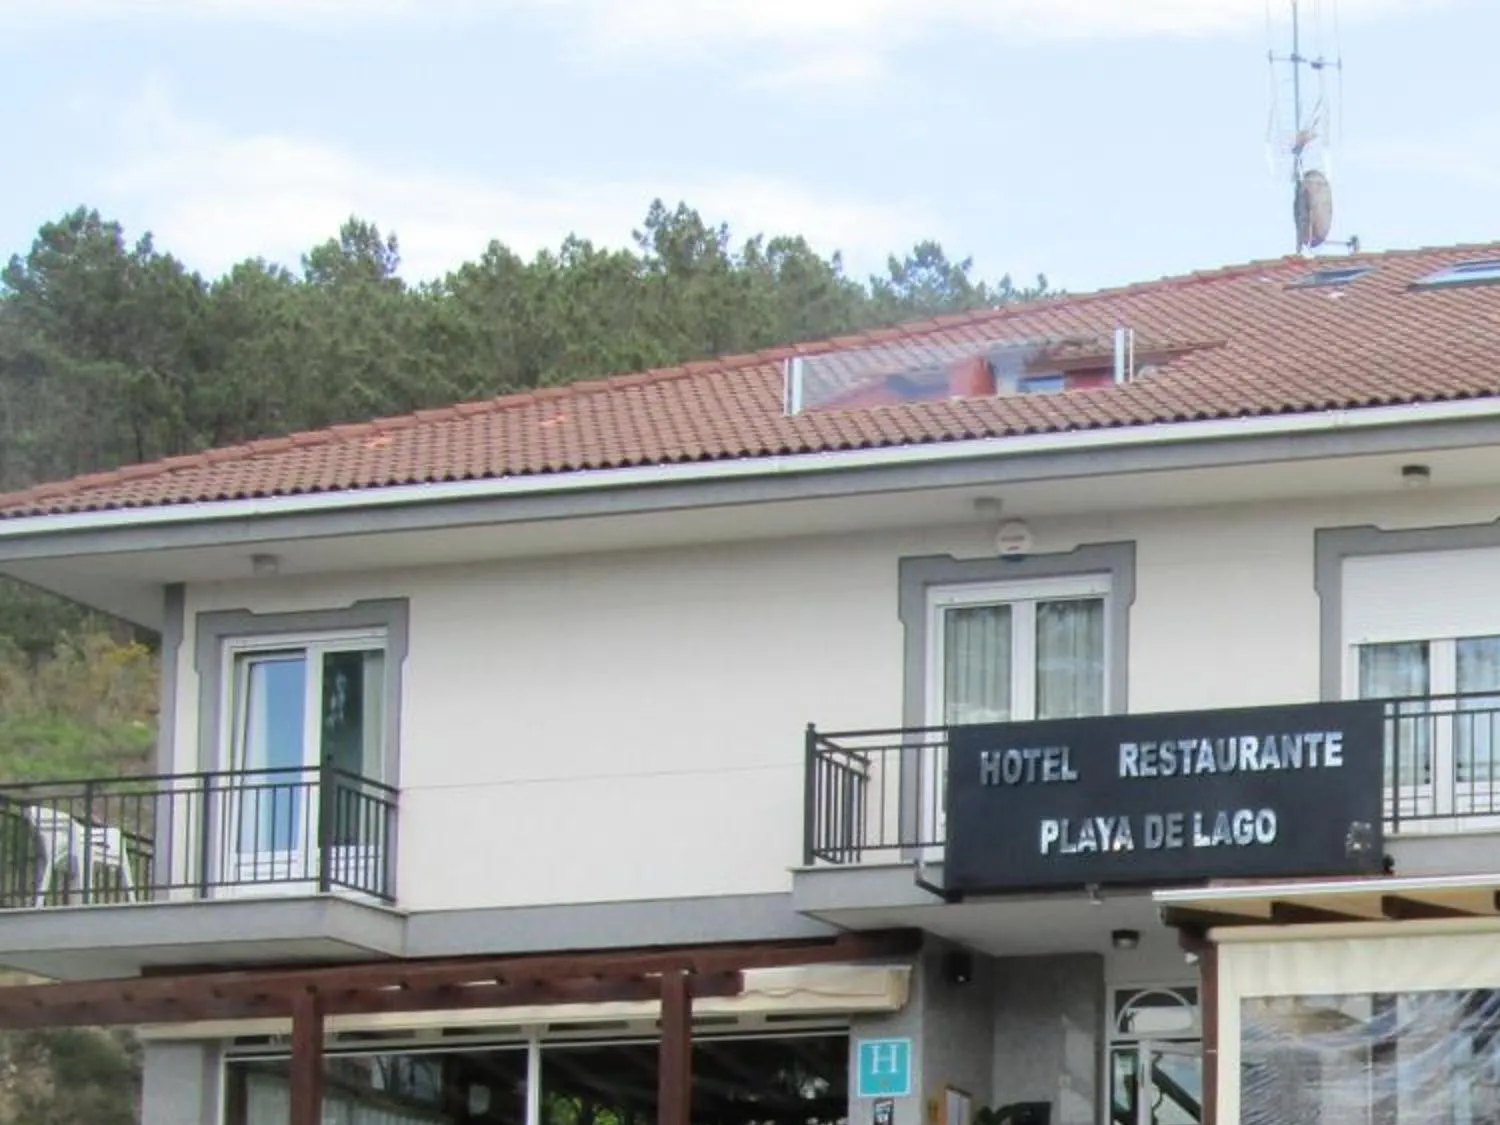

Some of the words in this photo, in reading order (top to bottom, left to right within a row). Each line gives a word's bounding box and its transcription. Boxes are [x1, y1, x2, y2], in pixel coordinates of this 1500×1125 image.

[980, 746, 1079, 785] HOTEL
[1119, 731, 1344, 778] RESTAURANTE
[1040, 815, 1135, 855] PLAYA
[1144, 812, 1184, 850] DE
[1193, 807, 1277, 848] LAGO
[871, 1044, 898, 1075] H
